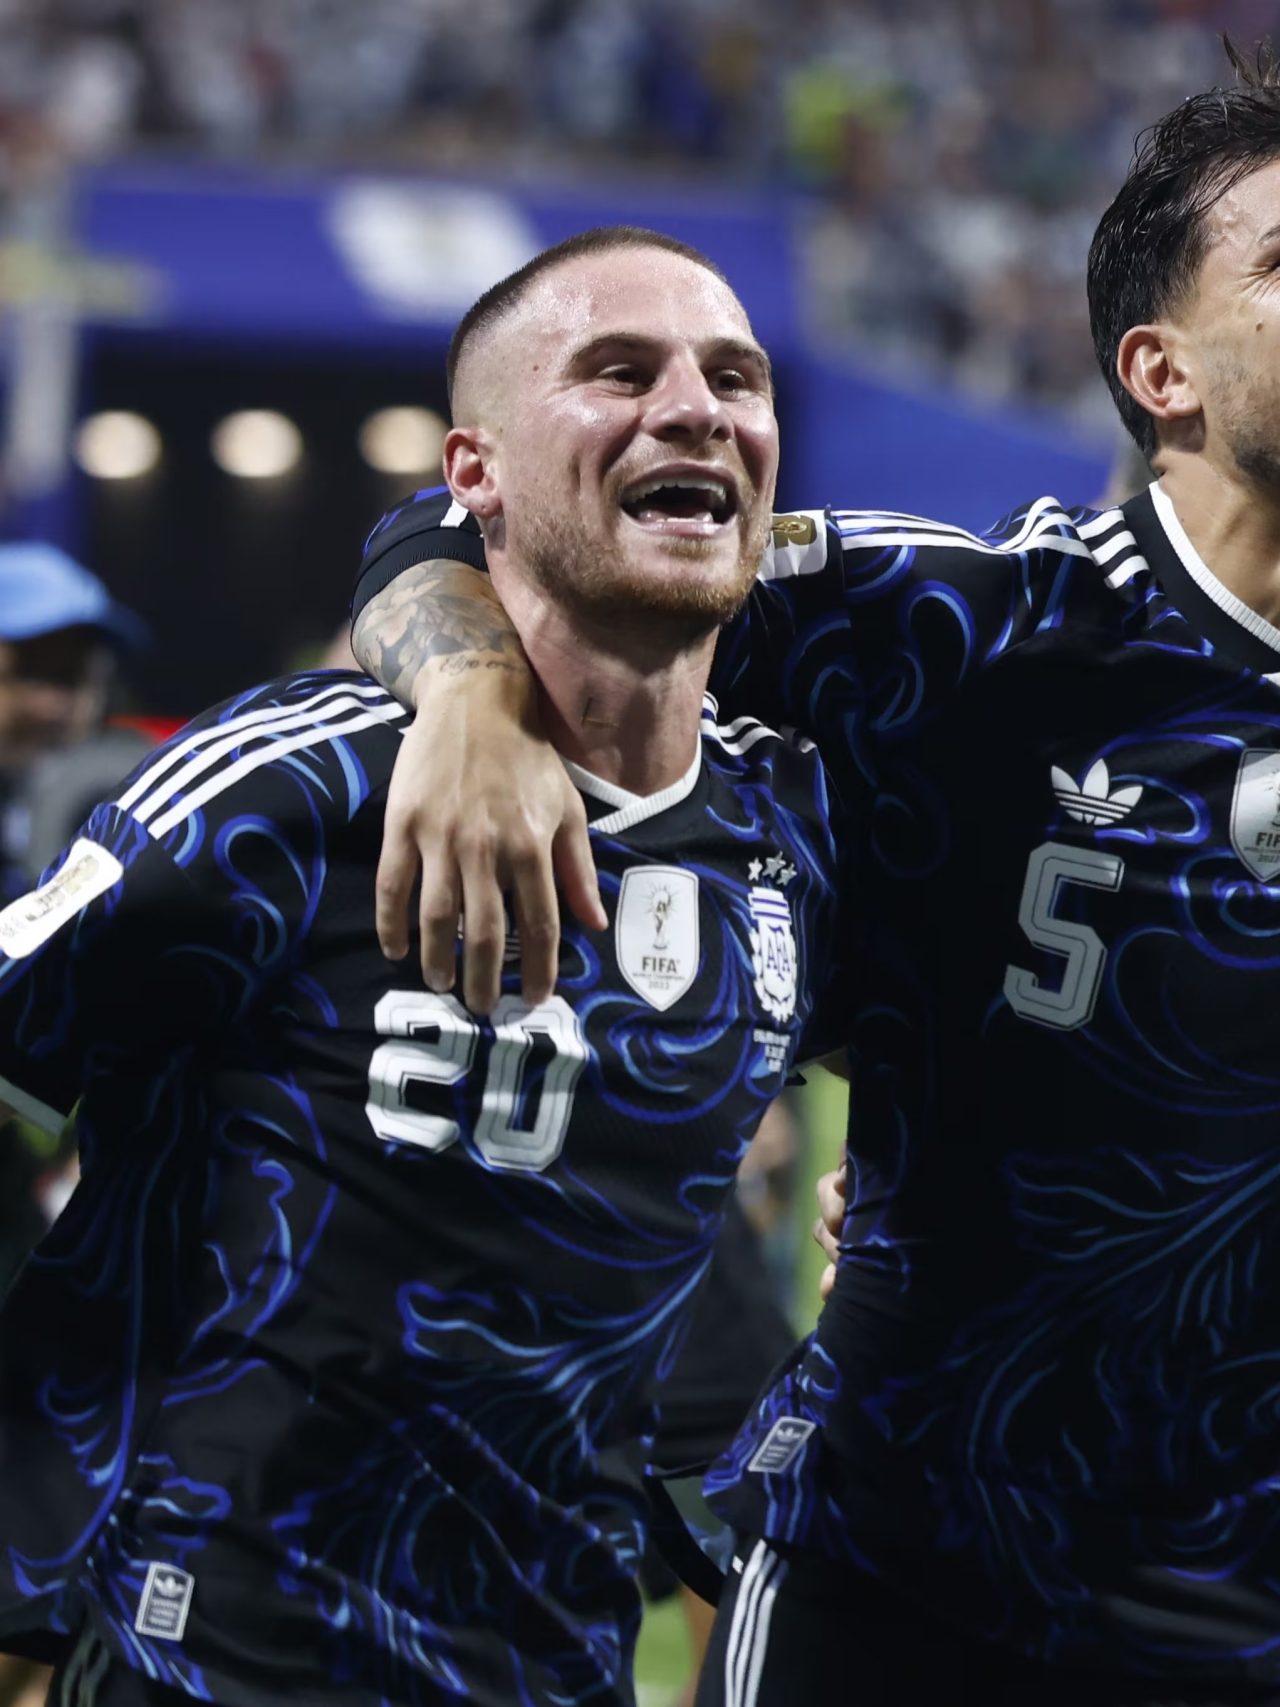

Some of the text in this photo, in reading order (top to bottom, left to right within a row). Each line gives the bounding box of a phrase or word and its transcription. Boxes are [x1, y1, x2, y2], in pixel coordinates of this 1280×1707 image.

[642, 956, 677, 974] FIFA
[1003, 841, 1125, 1031] 5
[365, 990, 589, 1172] 20
